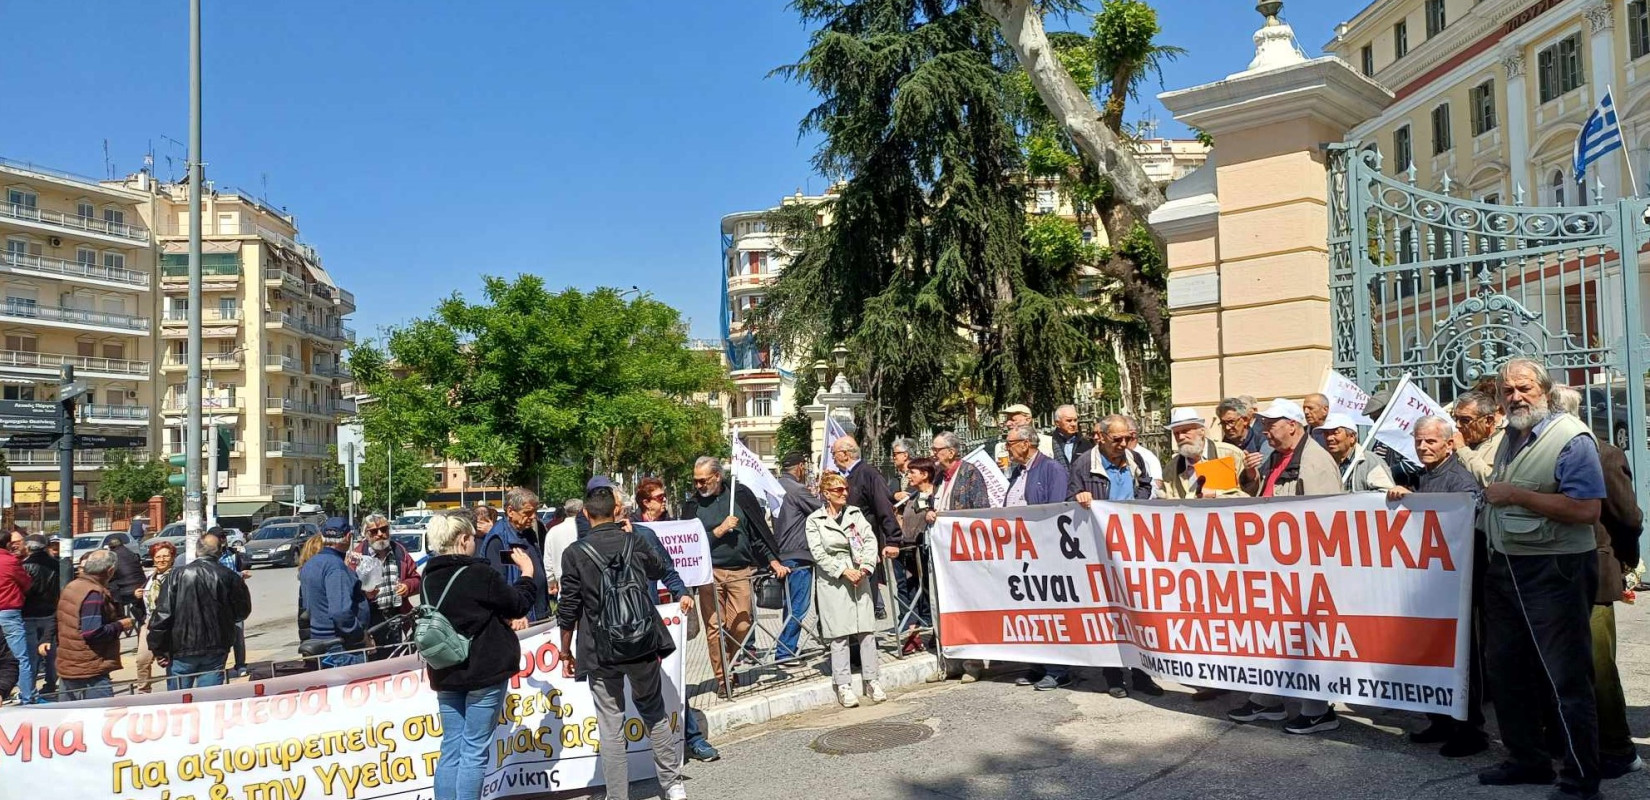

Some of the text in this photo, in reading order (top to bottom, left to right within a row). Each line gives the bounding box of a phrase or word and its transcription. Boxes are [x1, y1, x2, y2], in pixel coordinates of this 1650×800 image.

[657, 533, 699, 545] ΙΟΥΧΙΚΟ
[950, 510, 1456, 571] ΔΩΡΑ & ΑΝΑΔΡΟΜΙΚΑ
[1008, 562, 1338, 616] είναι ΠΛΗΡΩΜΕΝΑ
[1002, 612, 1358, 658] ΔΩΣΤΕ ΠΙΣΩ τα ΚΛΕΜΜΕΝΑ
[1199, 663, 1319, 692] ΣΥΝΤΑΞΙΟΥΧΩΝ
[1328, 677, 1351, 695] «Η
[0, 720, 87, 763] Μια
[102, 694, 201, 757] ζωή
[215, 683, 331, 740] μέσα
[342, 669, 430, 709] στο
[113, 759, 169, 793] Για
[177, 715, 396, 784] αξιοπρεπείς
[243, 775, 305, 800] την
[313, 750, 416, 799] Υγεία
[496, 726, 553, 768] μας
[482, 767, 561, 798] εσ/νίκης
